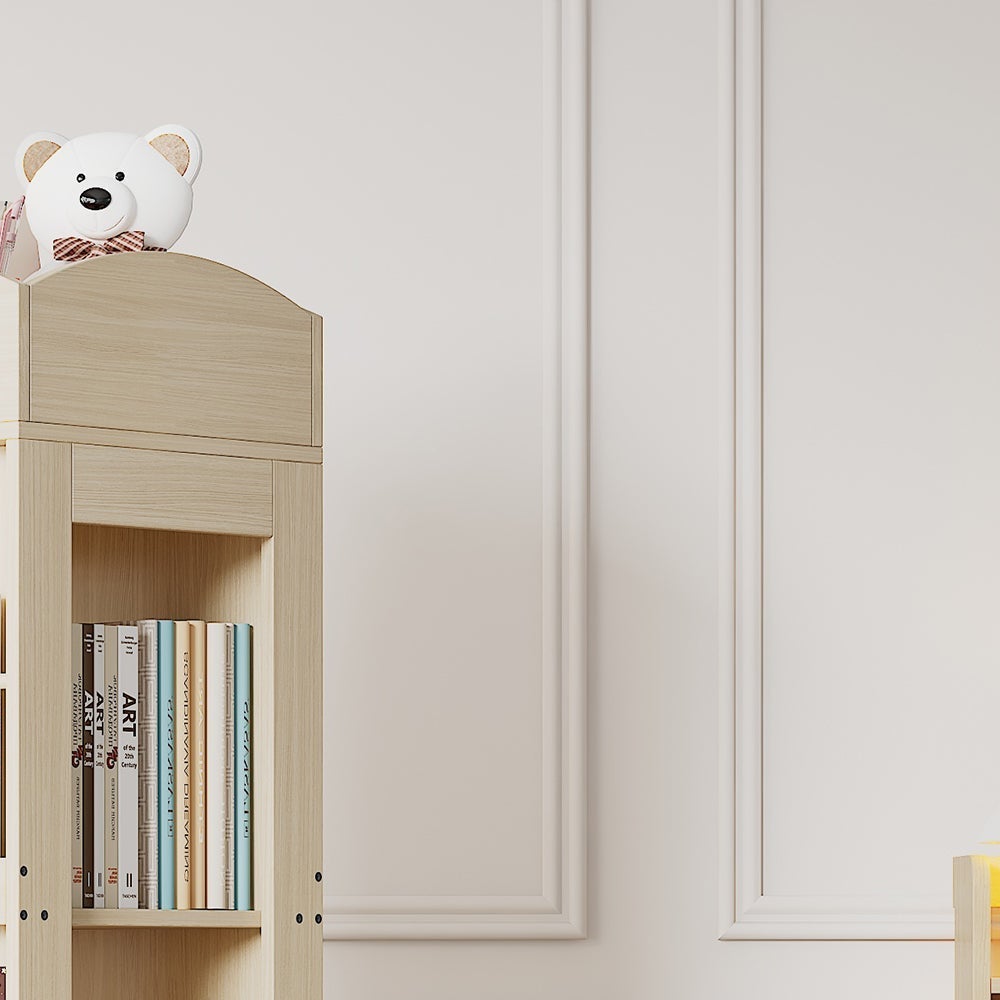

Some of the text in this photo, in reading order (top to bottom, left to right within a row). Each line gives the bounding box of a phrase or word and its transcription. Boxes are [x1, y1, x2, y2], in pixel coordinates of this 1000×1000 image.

[84, 690, 94, 736] ART
[96, 691, 104, 735] ART
[122, 692, 137, 737] ART
